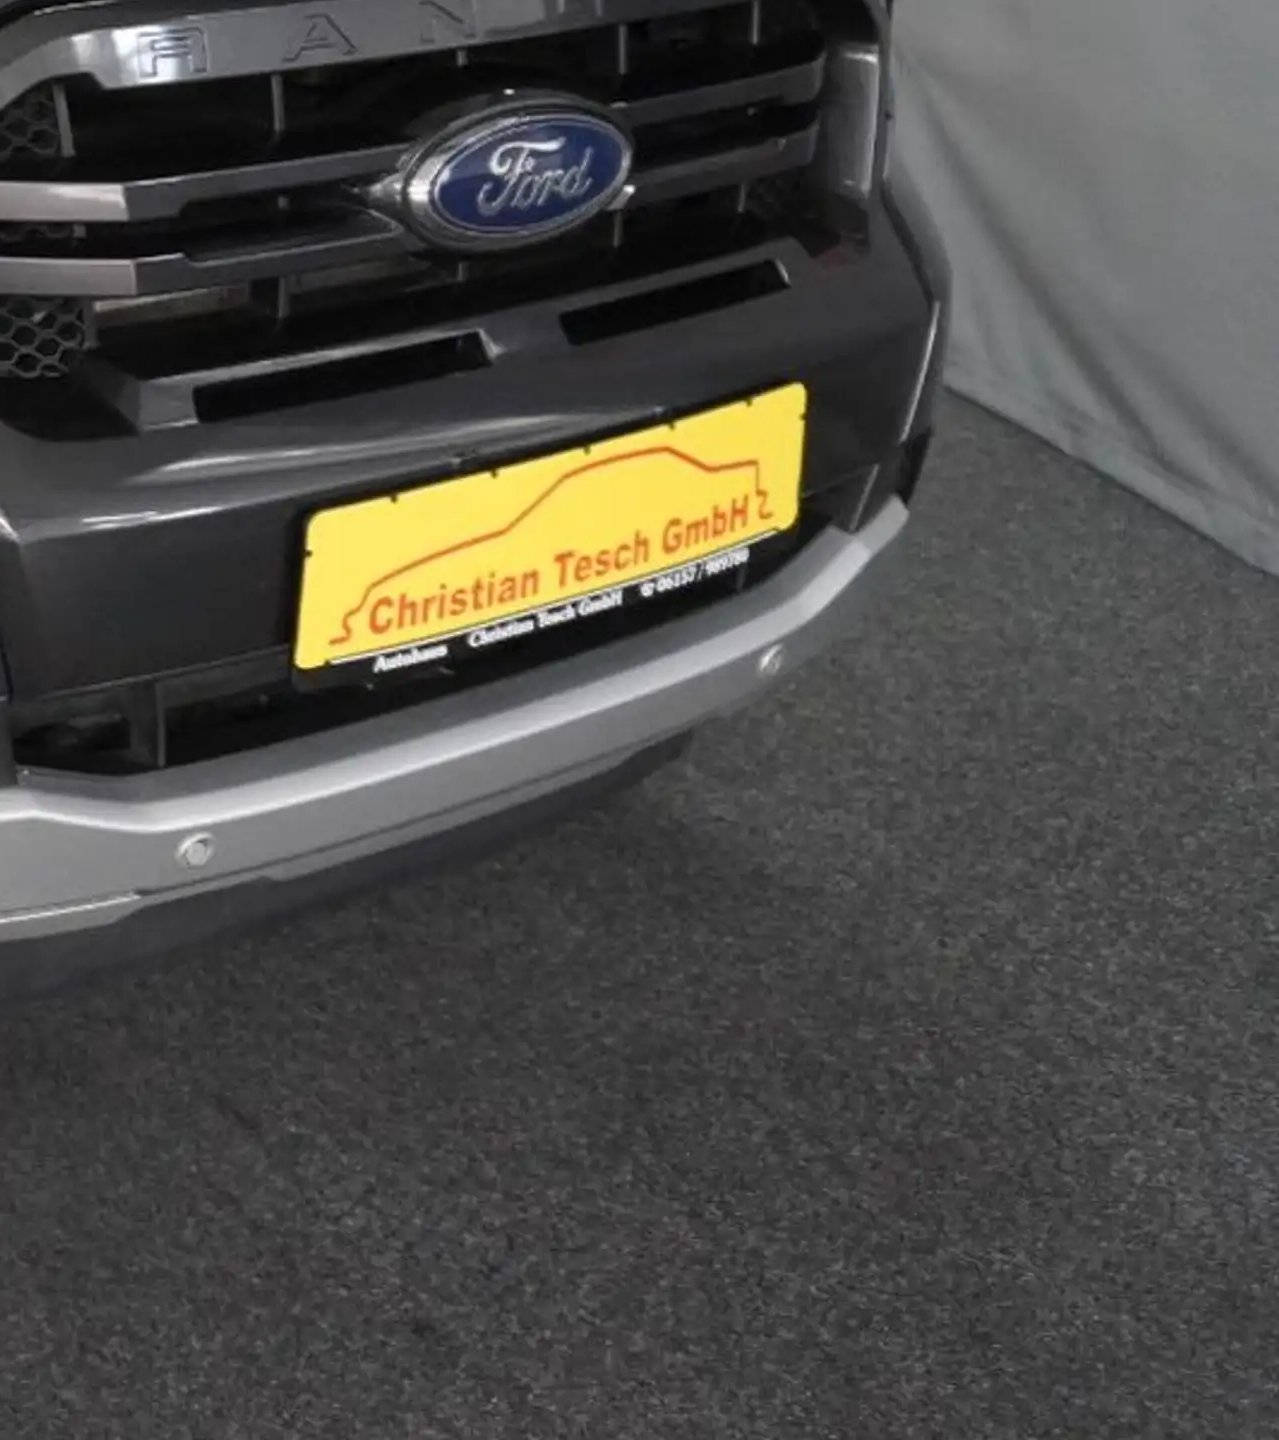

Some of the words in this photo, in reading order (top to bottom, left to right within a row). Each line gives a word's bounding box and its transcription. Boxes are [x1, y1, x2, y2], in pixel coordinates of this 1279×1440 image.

[477, 135, 595, 217] Ford
[369, 569, 540, 635] Christian
[553, 530, 650, 588] Tesch
[661, 493, 749, 556] GmbH
[372, 644, 448, 674] Autohaus
[467, 619, 535, 648] Christian
[537, 604, 576, 628] Tesch
[578, 590, 623, 616] GmbH
